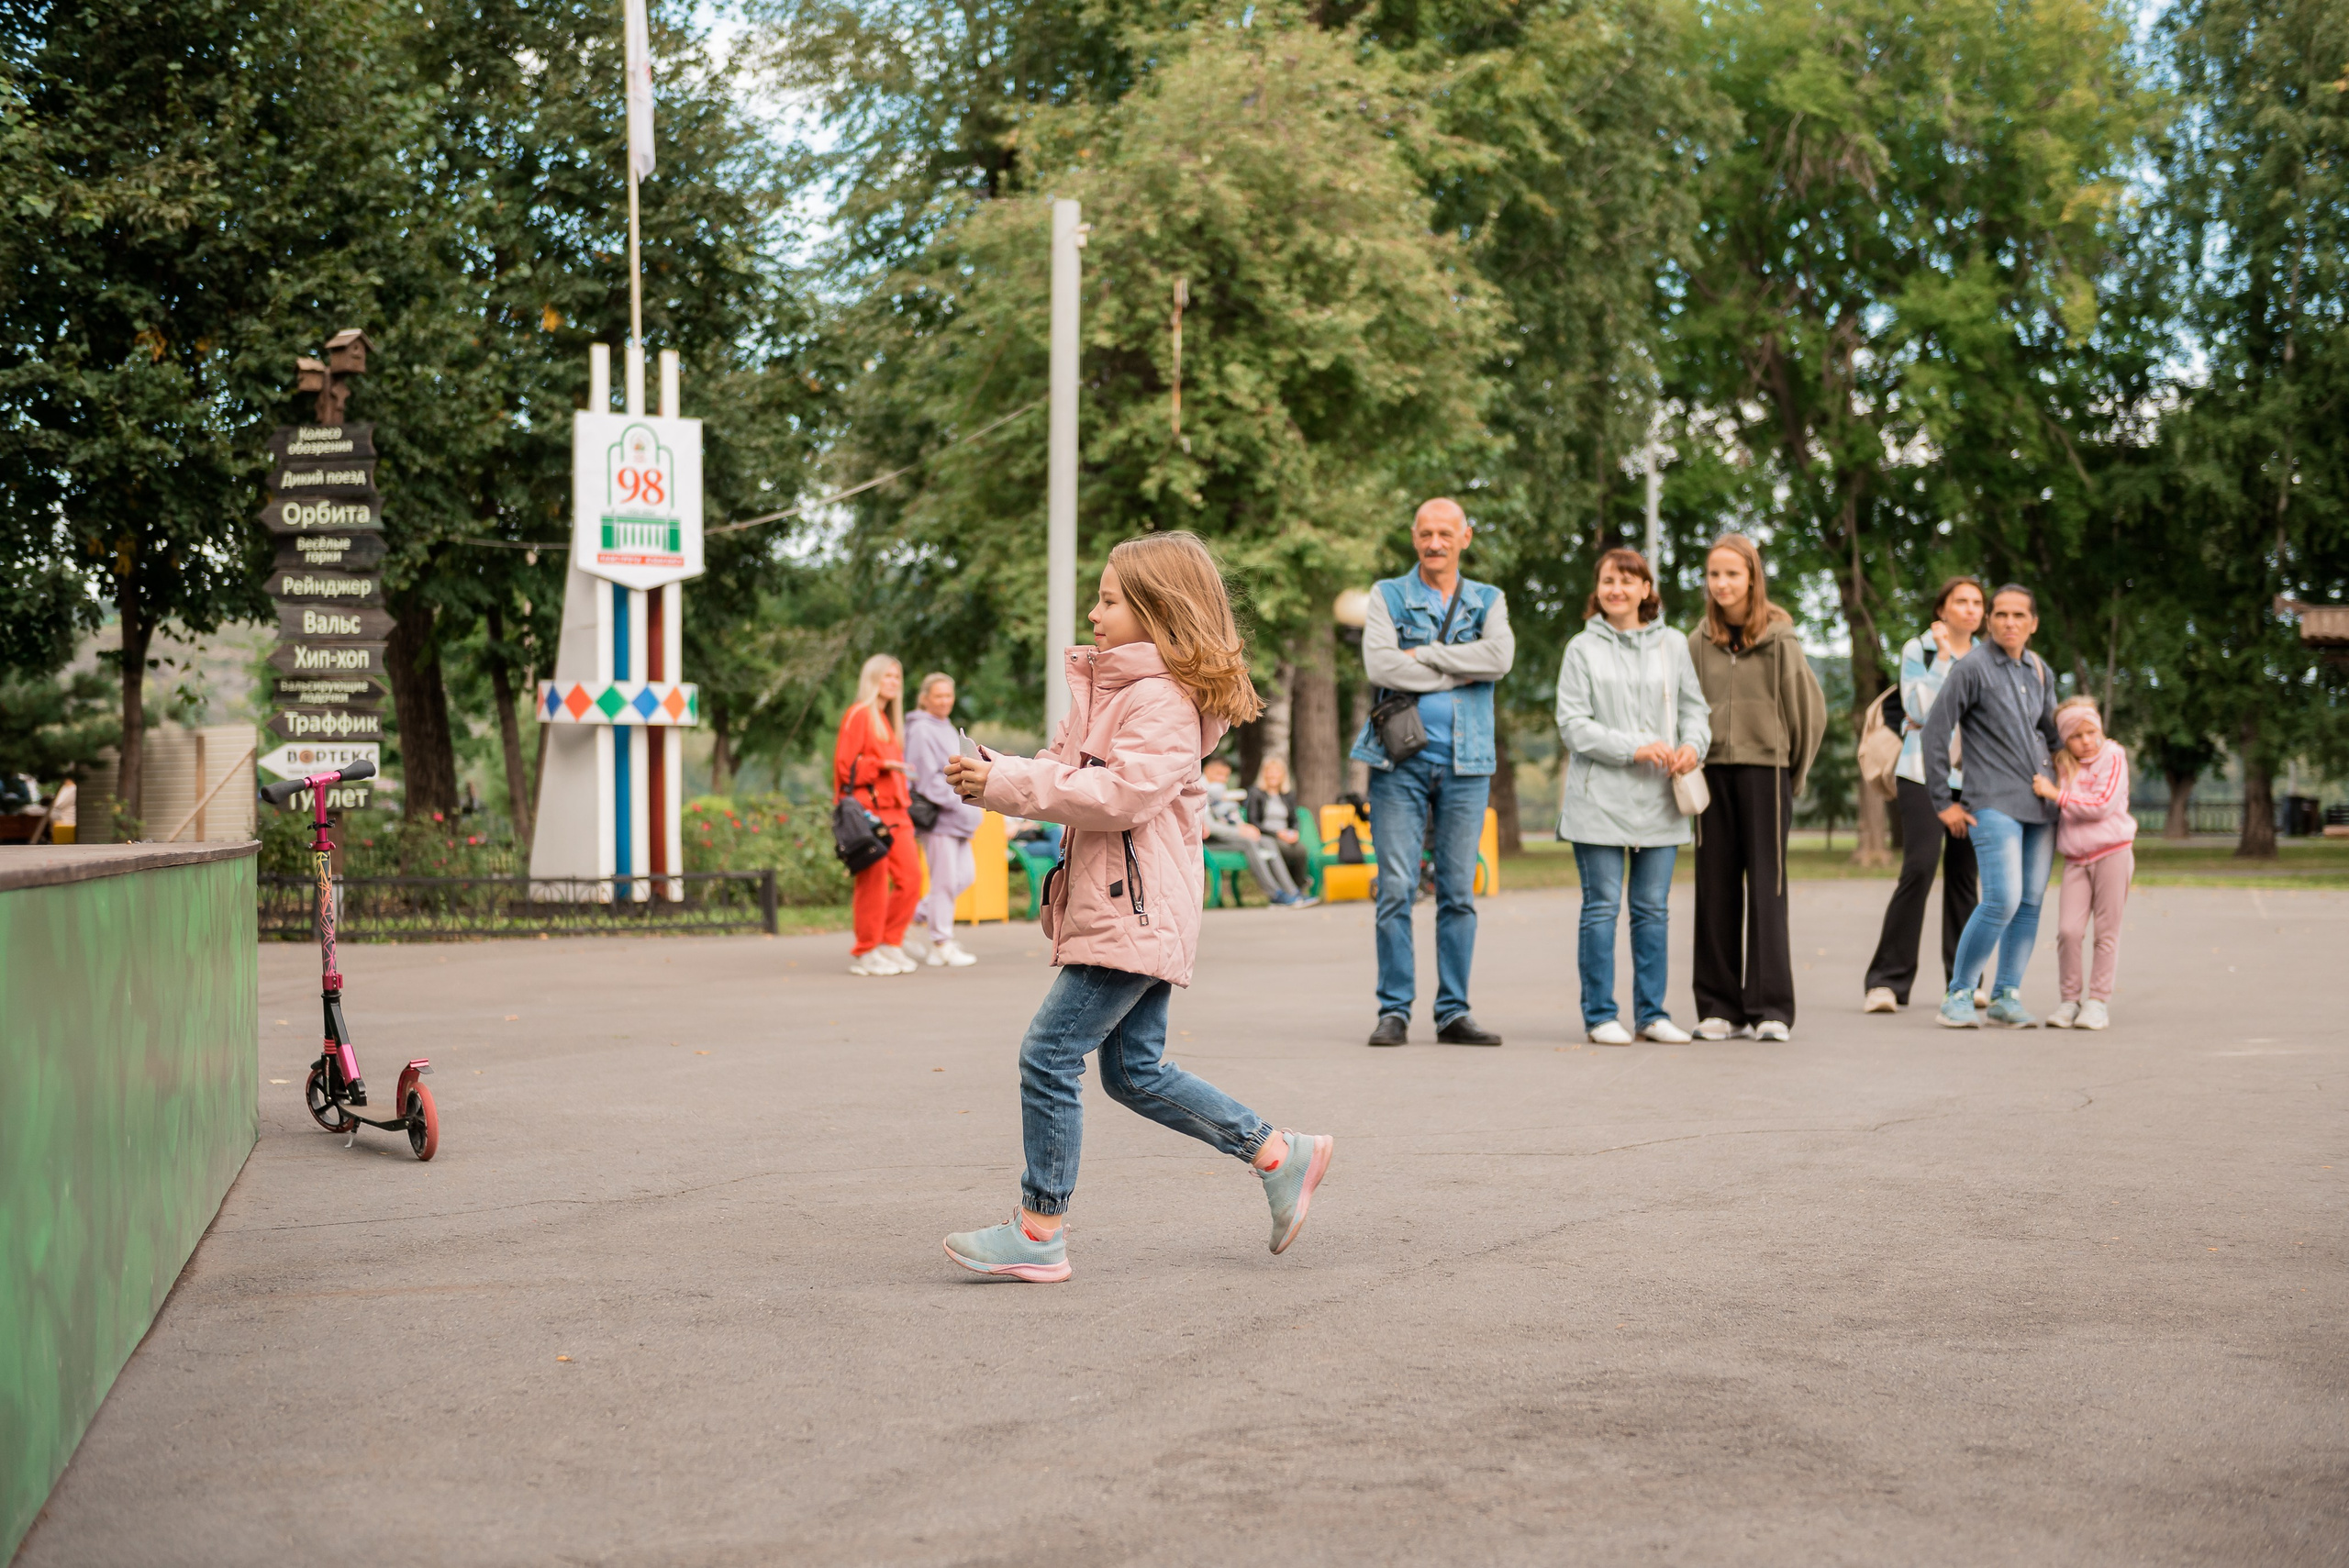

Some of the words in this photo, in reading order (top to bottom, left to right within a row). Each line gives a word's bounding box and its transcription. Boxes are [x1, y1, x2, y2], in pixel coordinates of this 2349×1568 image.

[298, 426, 342, 440] Колесо
[287, 439, 353, 455] обозрения
[281, 469, 324, 489] Дикий
[326, 470, 366, 485] поезд
[618, 467, 664, 506] 98
[282, 500, 370, 528] Орбита
[296, 535, 351, 550] Весёлые
[305, 550, 342, 565] горки
[282, 575, 372, 598] Рейнджер
[304, 610, 362, 634] Вальс
[295, 645, 370, 669] Хип-хоп
[280, 680, 369, 693] Вальсирующие
[299, 693, 349, 704] лодочки
[284, 710, 379, 737] Траффик
[289, 788, 369, 812] Тулет
